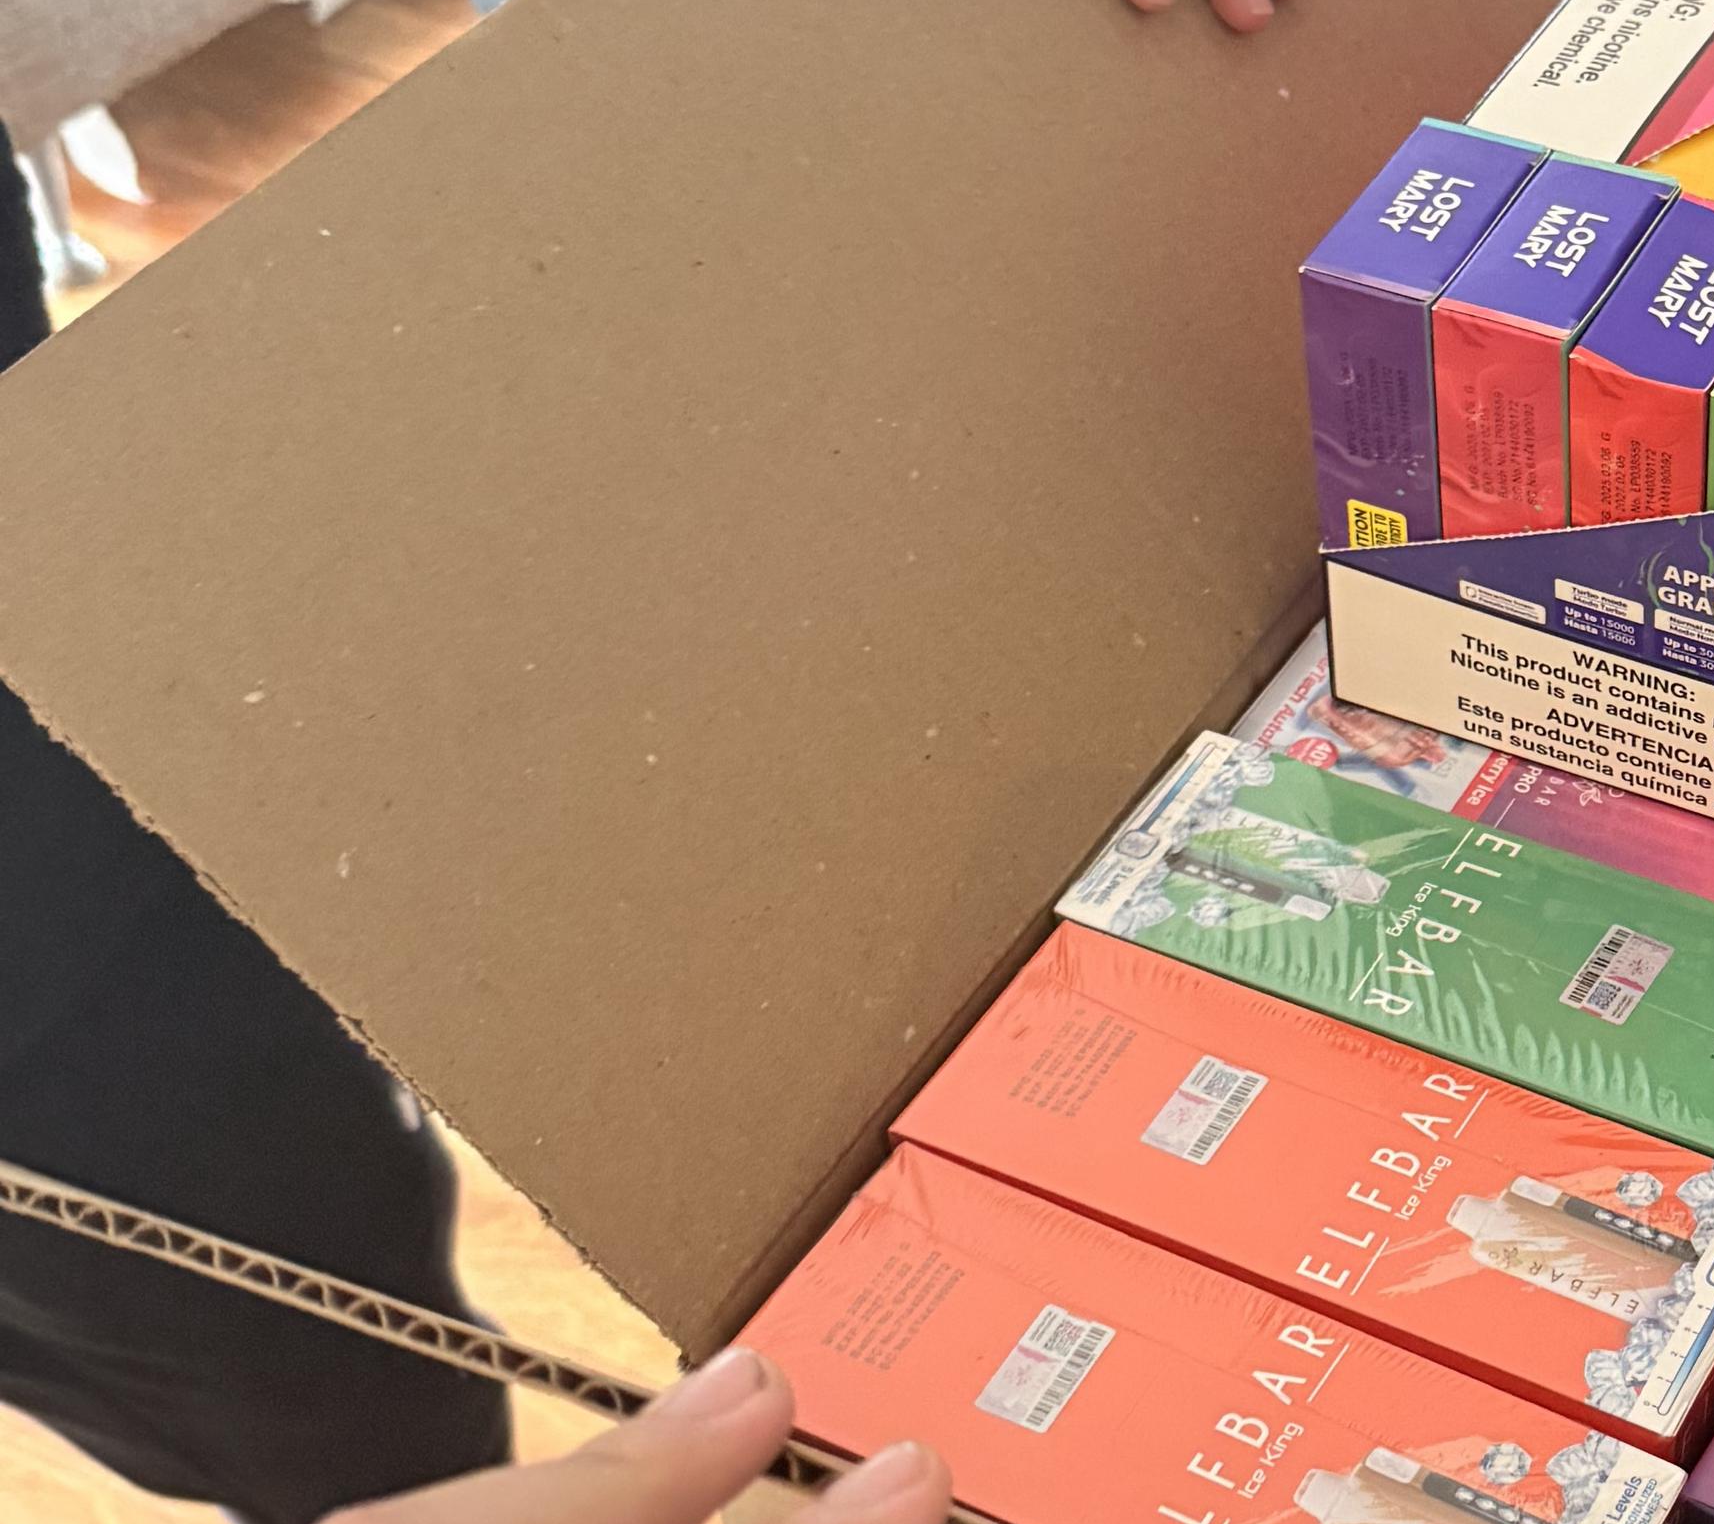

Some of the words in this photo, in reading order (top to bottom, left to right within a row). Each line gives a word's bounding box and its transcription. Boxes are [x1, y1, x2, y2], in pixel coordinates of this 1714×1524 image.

[1533, 16, 1604, 88] chemical.
[1575, 19, 1642, 84] nicotine.
[1378, 169, 1443, 234] MARY
[1411, 176, 1475, 242] LOST
[1563, 616, 1598, 635] Hasta
[1601, 628, 1636, 646] 15000
[1565, 606, 1582, 619] Up
[1583, 611, 1598, 623] to
[1600, 616, 1635, 634] 15000
[1664, 637, 1681, 650] Up
[1682, 642, 1696, 653] to
[1461, 633, 1509, 661] This
[1516, 654, 1602, 693] product
[1609, 683, 1706, 725] contains
[1572, 650, 1696, 702] WARNING:
[1662, 647, 1698, 666] Hasta
[1450, 649, 1540, 691] Nicotine
[1547, 682, 1566, 699] is
[1572, 691, 1599, 711] an
[1606, 699, 1708, 745] addictive
[1458, 695, 1505, 723] Este
[1511, 714, 1609, 758] producto
[1616, 750, 1712, 790] contiene
[1463, 719, 1503, 742] una
[1509, 733, 1614, 777] sustancia
[1621, 766, 1708, 808] química
[1361, 830, 1525, 1018] ELFBAR
[1384, 907, 1423, 939] King
[1406, 880, 1441, 912] Ice
[1294, 1069, 1478, 1296] ELFBAR
[1609, 1475, 1642, 1522] Levels
